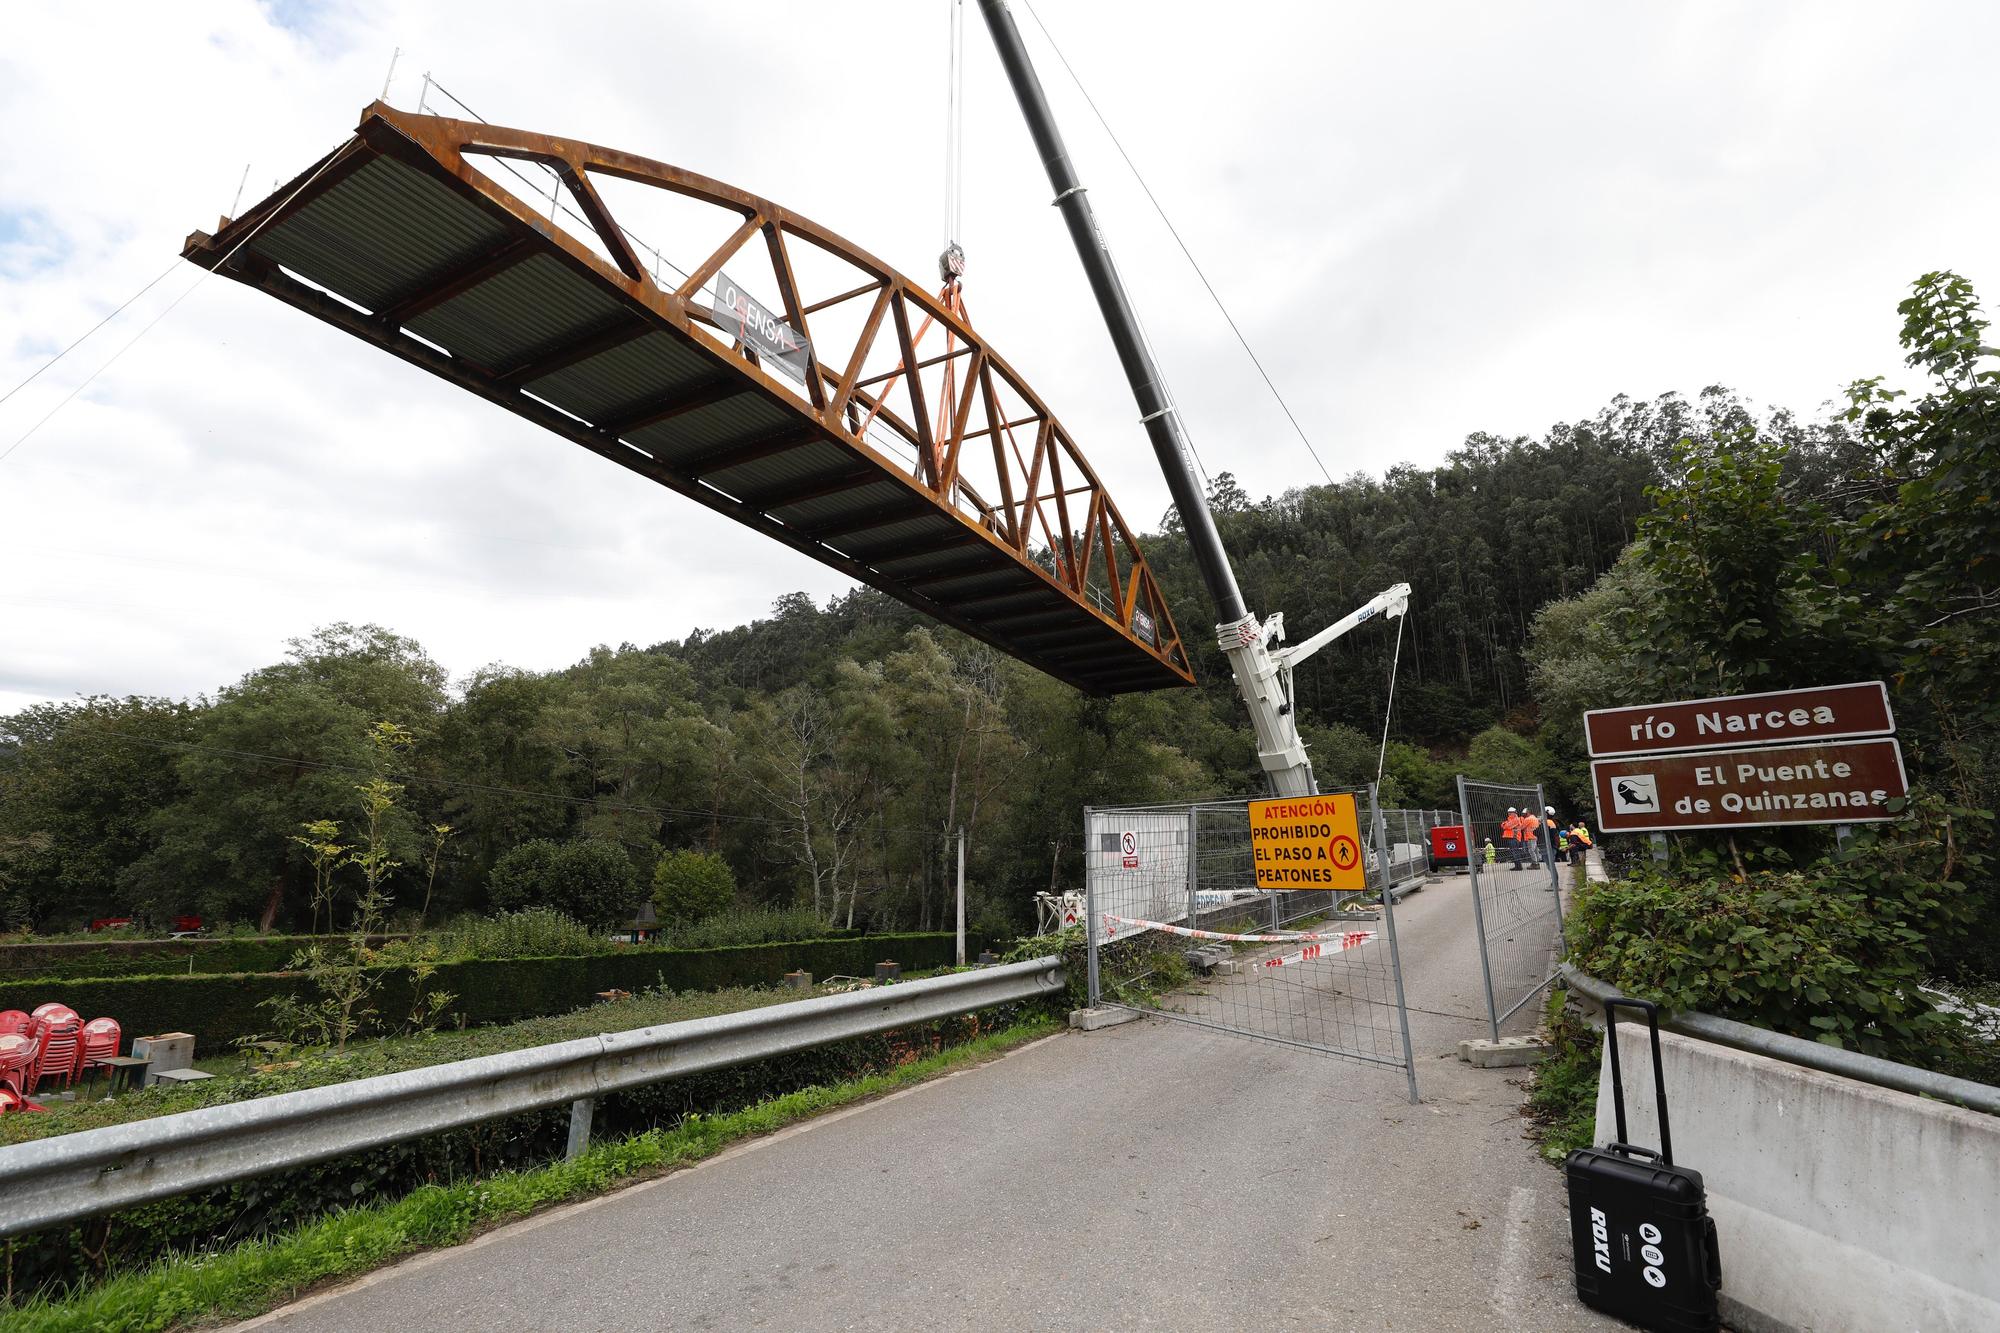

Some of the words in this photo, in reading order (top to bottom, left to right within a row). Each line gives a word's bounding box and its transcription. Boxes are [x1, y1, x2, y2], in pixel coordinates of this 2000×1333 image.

[1357, 606, 1375, 622] ROXU
[1630, 715, 1676, 741] río
[1696, 705, 1835, 735] Narcea
[1694, 765, 1727, 786] El
[1738, 759, 1852, 783] Puente
[1264, 800, 1336, 819] ATENCIÓN
[1674, 796, 1711, 815] de
[1720, 788, 1888, 814] Quinzanas
[1253, 824, 1331, 840] PROHIBIDO
[1256, 848, 1271, 861] EL
[1275, 847, 1312, 860] PASO
[1317, 846, 1327, 860] A
[1258, 868, 1332, 883] PEATONES
[1590, 1206, 1612, 1274] ROXU
